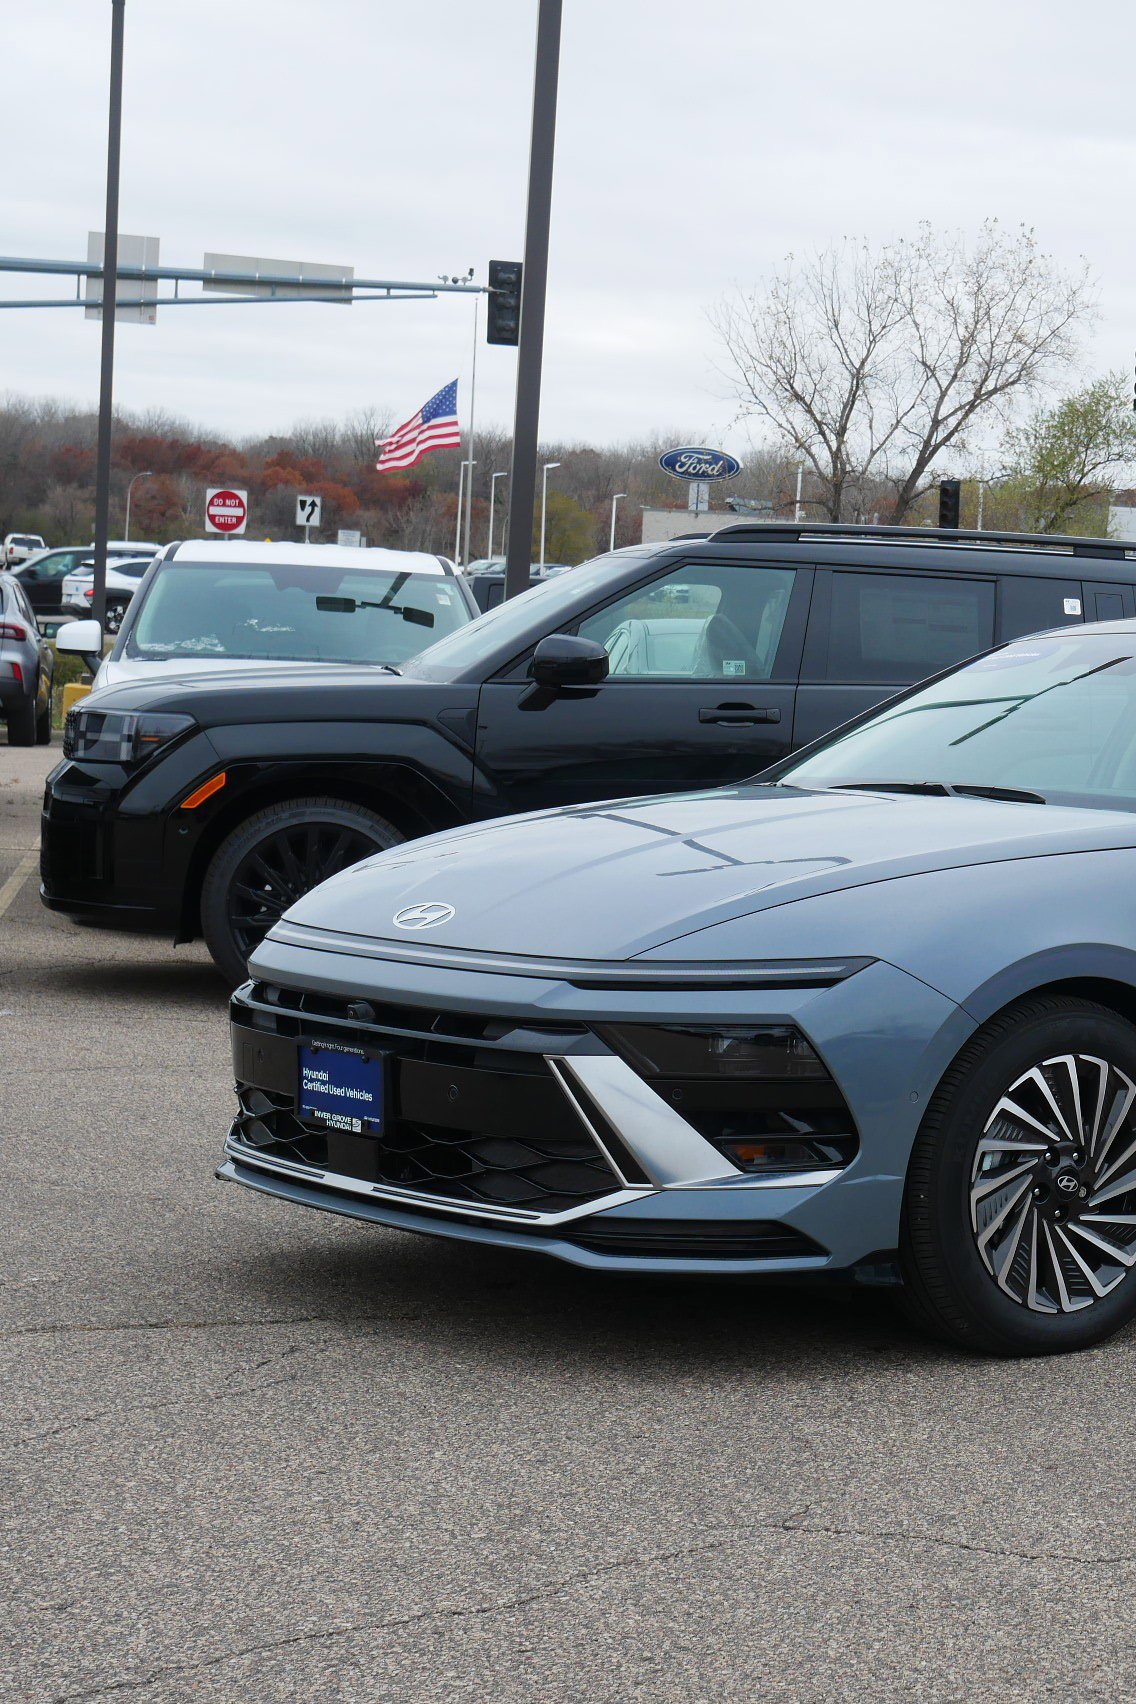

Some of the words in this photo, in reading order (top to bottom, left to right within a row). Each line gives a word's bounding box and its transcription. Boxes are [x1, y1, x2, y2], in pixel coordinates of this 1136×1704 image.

[675, 452, 724, 476] Ford
[213, 498, 223, 506] DO
[225, 499, 240, 507] NOT
[215, 516, 237, 525] ENTER
[302, 1067, 329, 1081] Hyundai
[302, 1079, 328, 1093] Certified
[329, 1084, 345, 1097] Used
[345, 1087, 373, 1102] Vehicles
[314, 1110, 331, 1119] INVER
[332, 1113, 352, 1124] GROVE
[326, 1120, 352, 1131] HYUNDAI
